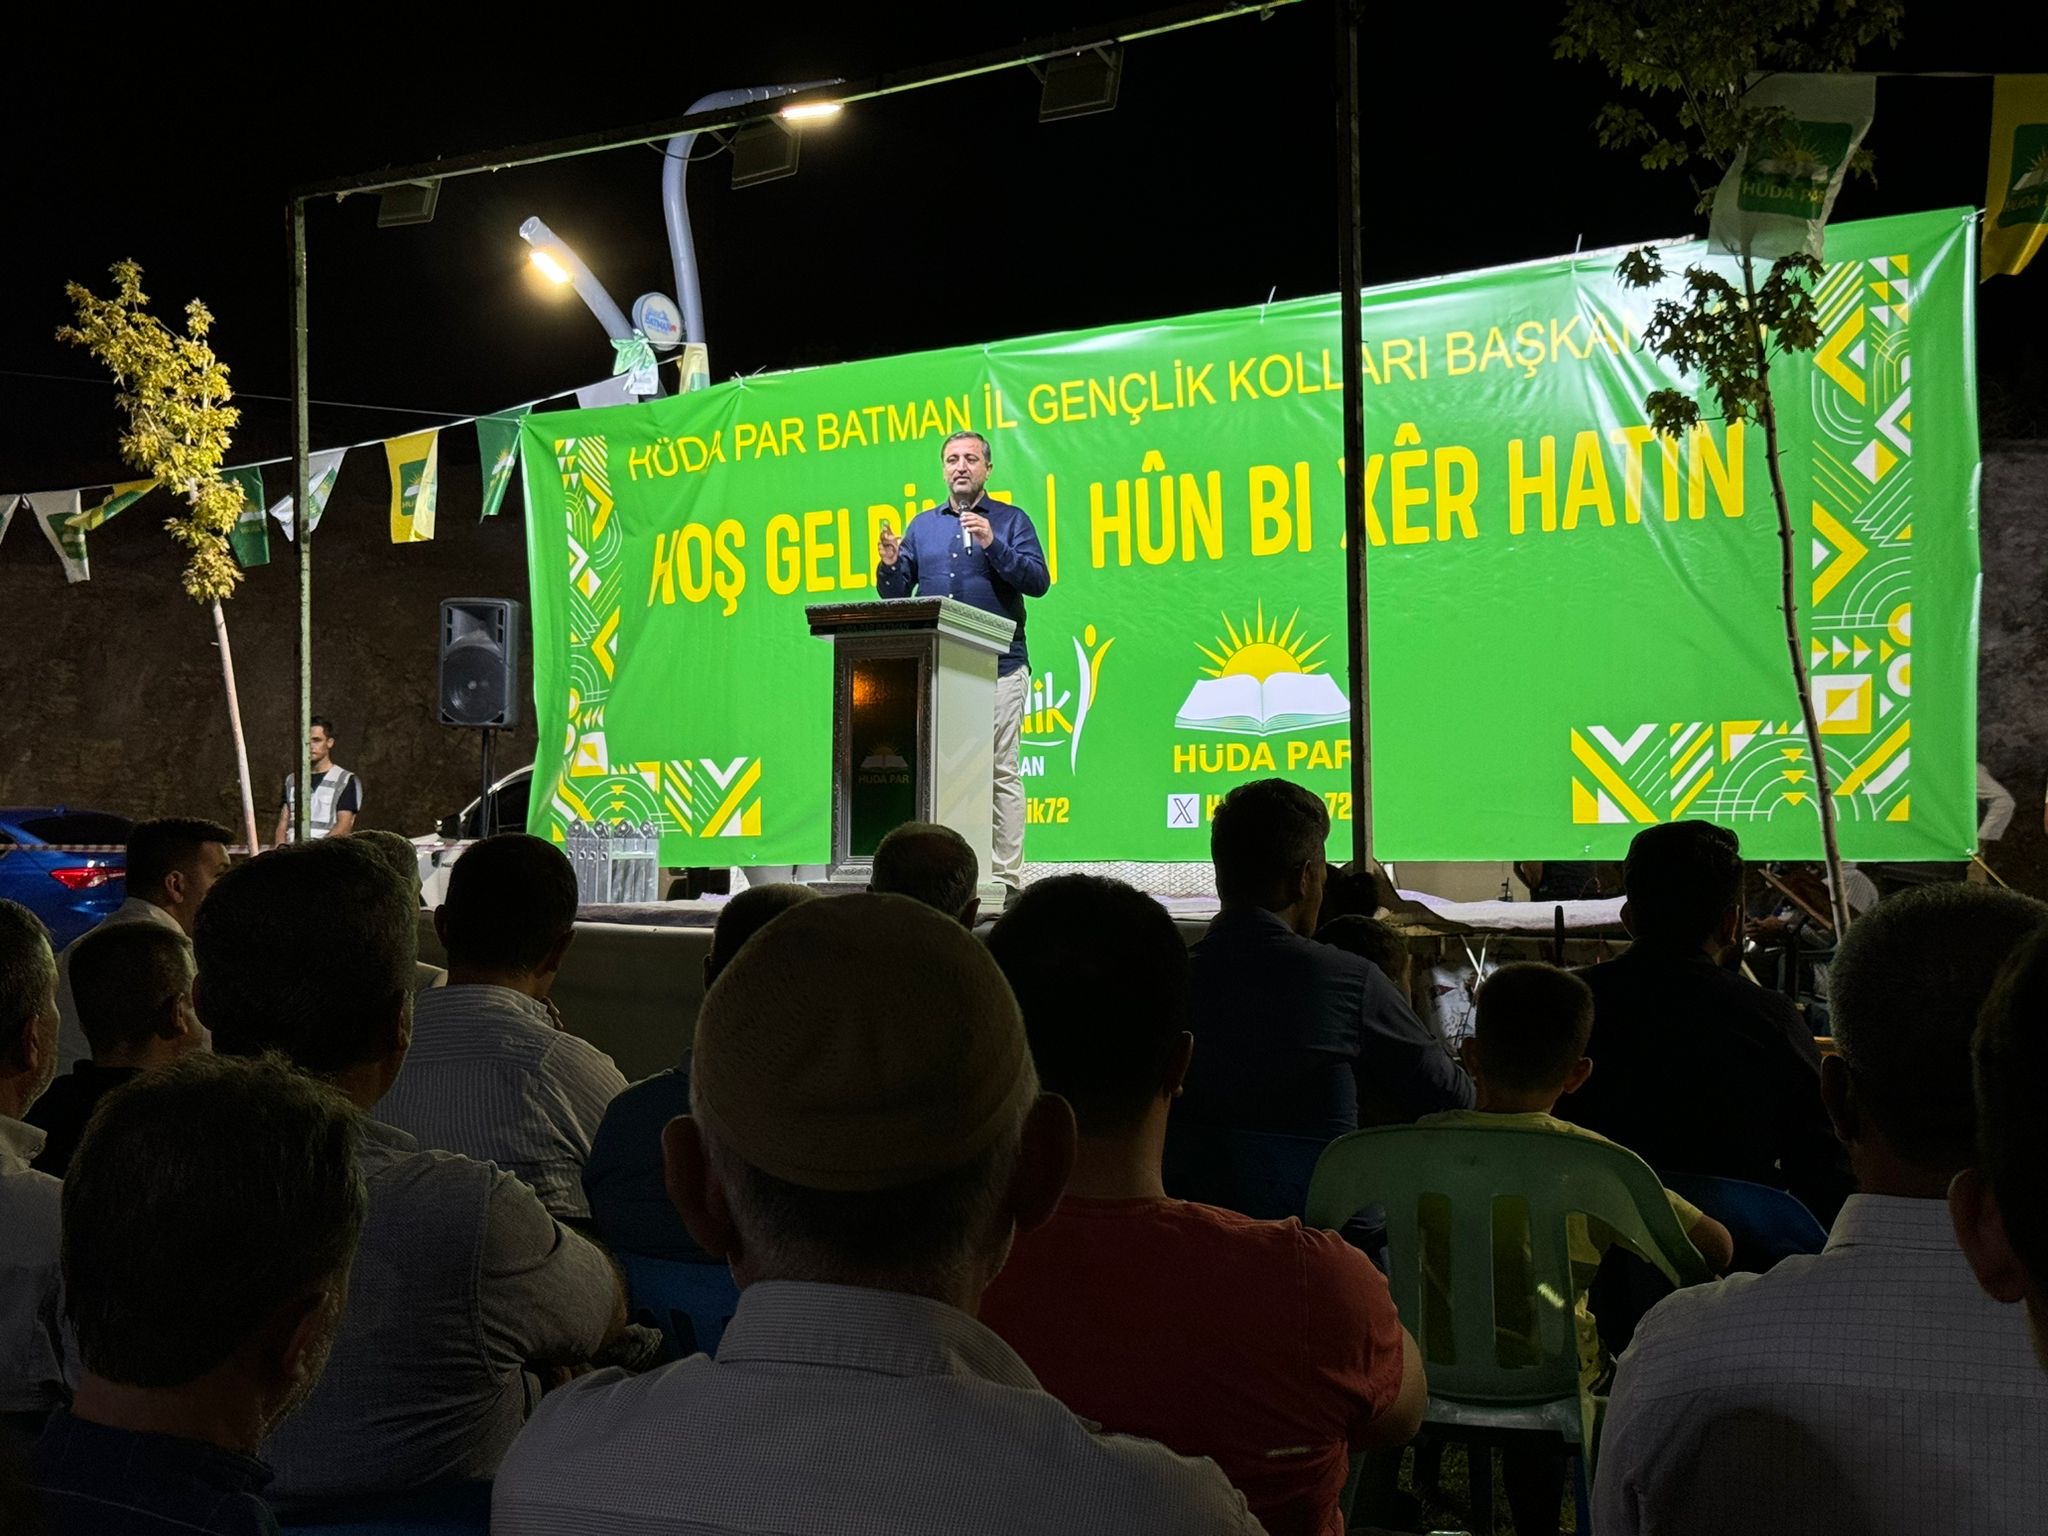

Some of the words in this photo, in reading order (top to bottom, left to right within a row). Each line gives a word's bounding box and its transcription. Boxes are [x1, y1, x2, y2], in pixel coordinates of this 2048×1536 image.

[628, 430, 727, 481] HÜDA
[735, 417, 807, 461] PAR
[817, 393, 972, 451] BATMAN
[983, 382, 1017, 430] İL
[1027, 360, 1217, 426] GENÇLİK
[648, 518, 747, 617] HOŞ
[1089, 449, 1224, 569] HÛN
[1248, 461, 1312, 556] BI
[1507, 416, 1745, 535] HATIN
[1173, 742, 1277, 773] HÜDA
